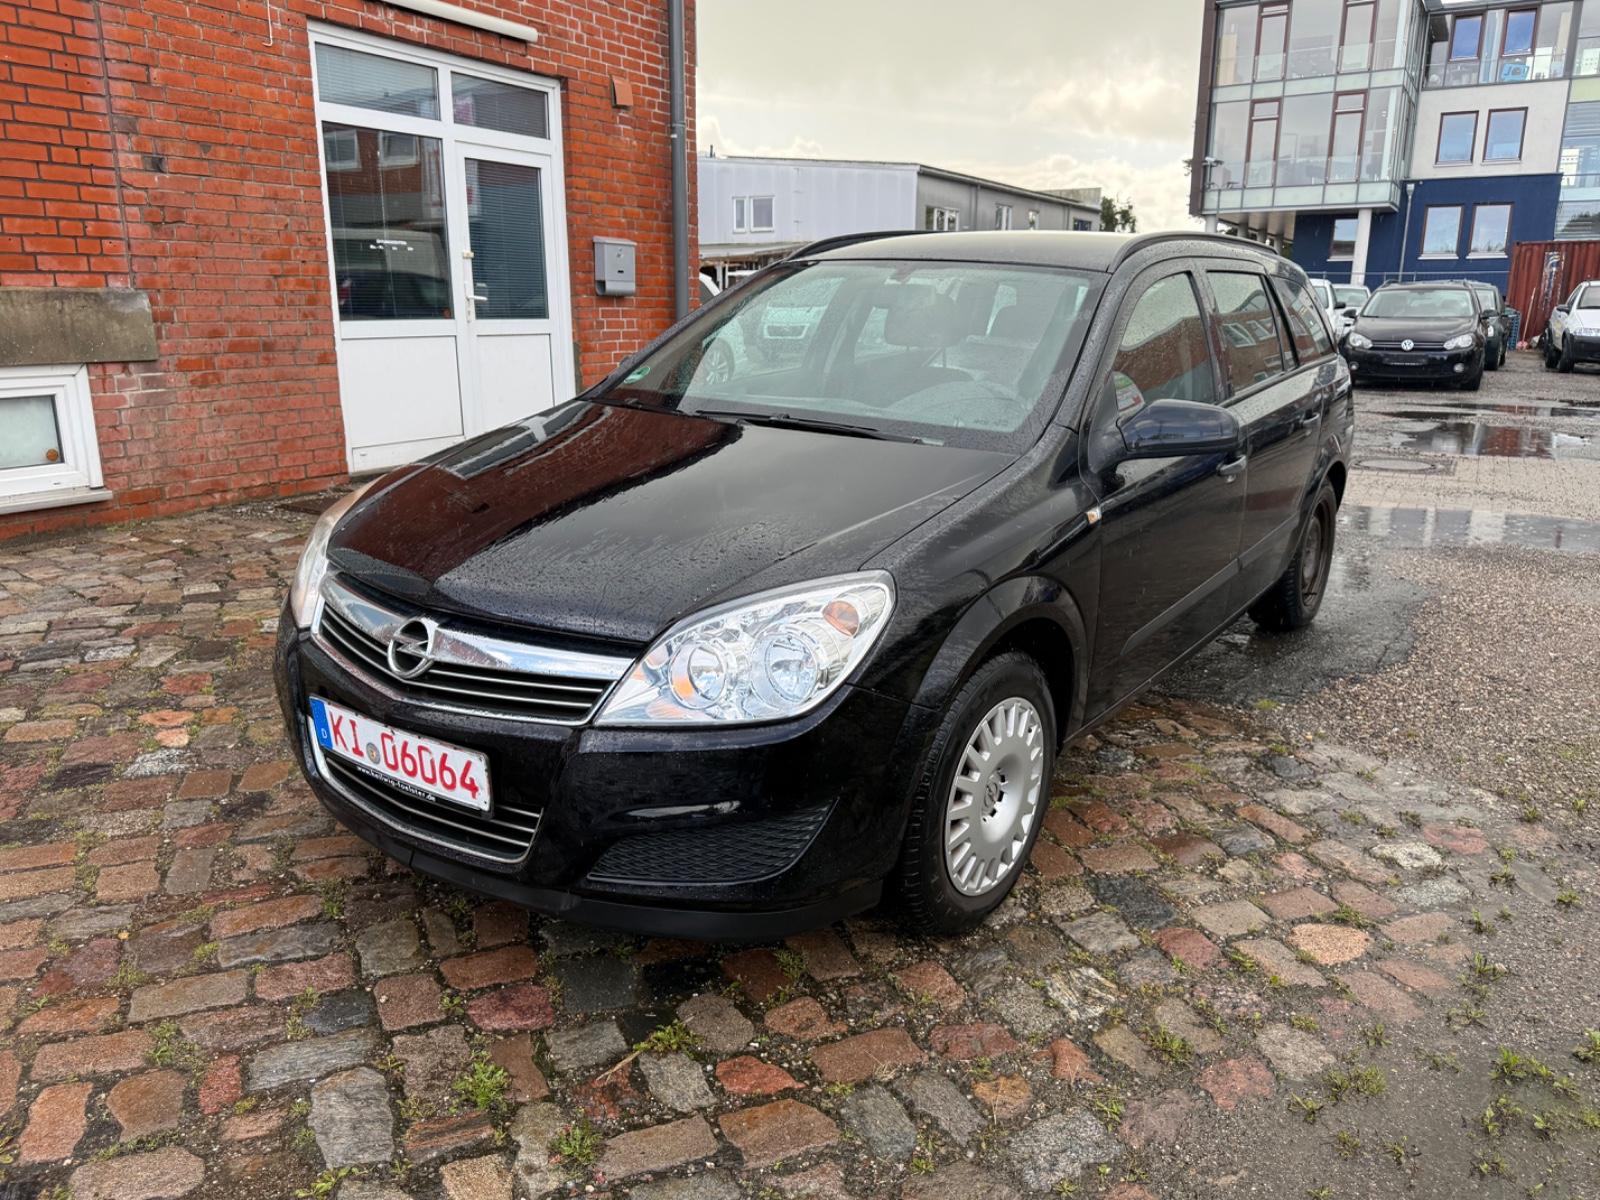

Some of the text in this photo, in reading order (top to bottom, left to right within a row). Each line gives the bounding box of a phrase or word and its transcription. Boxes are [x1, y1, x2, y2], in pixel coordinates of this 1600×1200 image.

[322, 728, 328, 740] D
[329, 712, 480, 799] KI 06064
